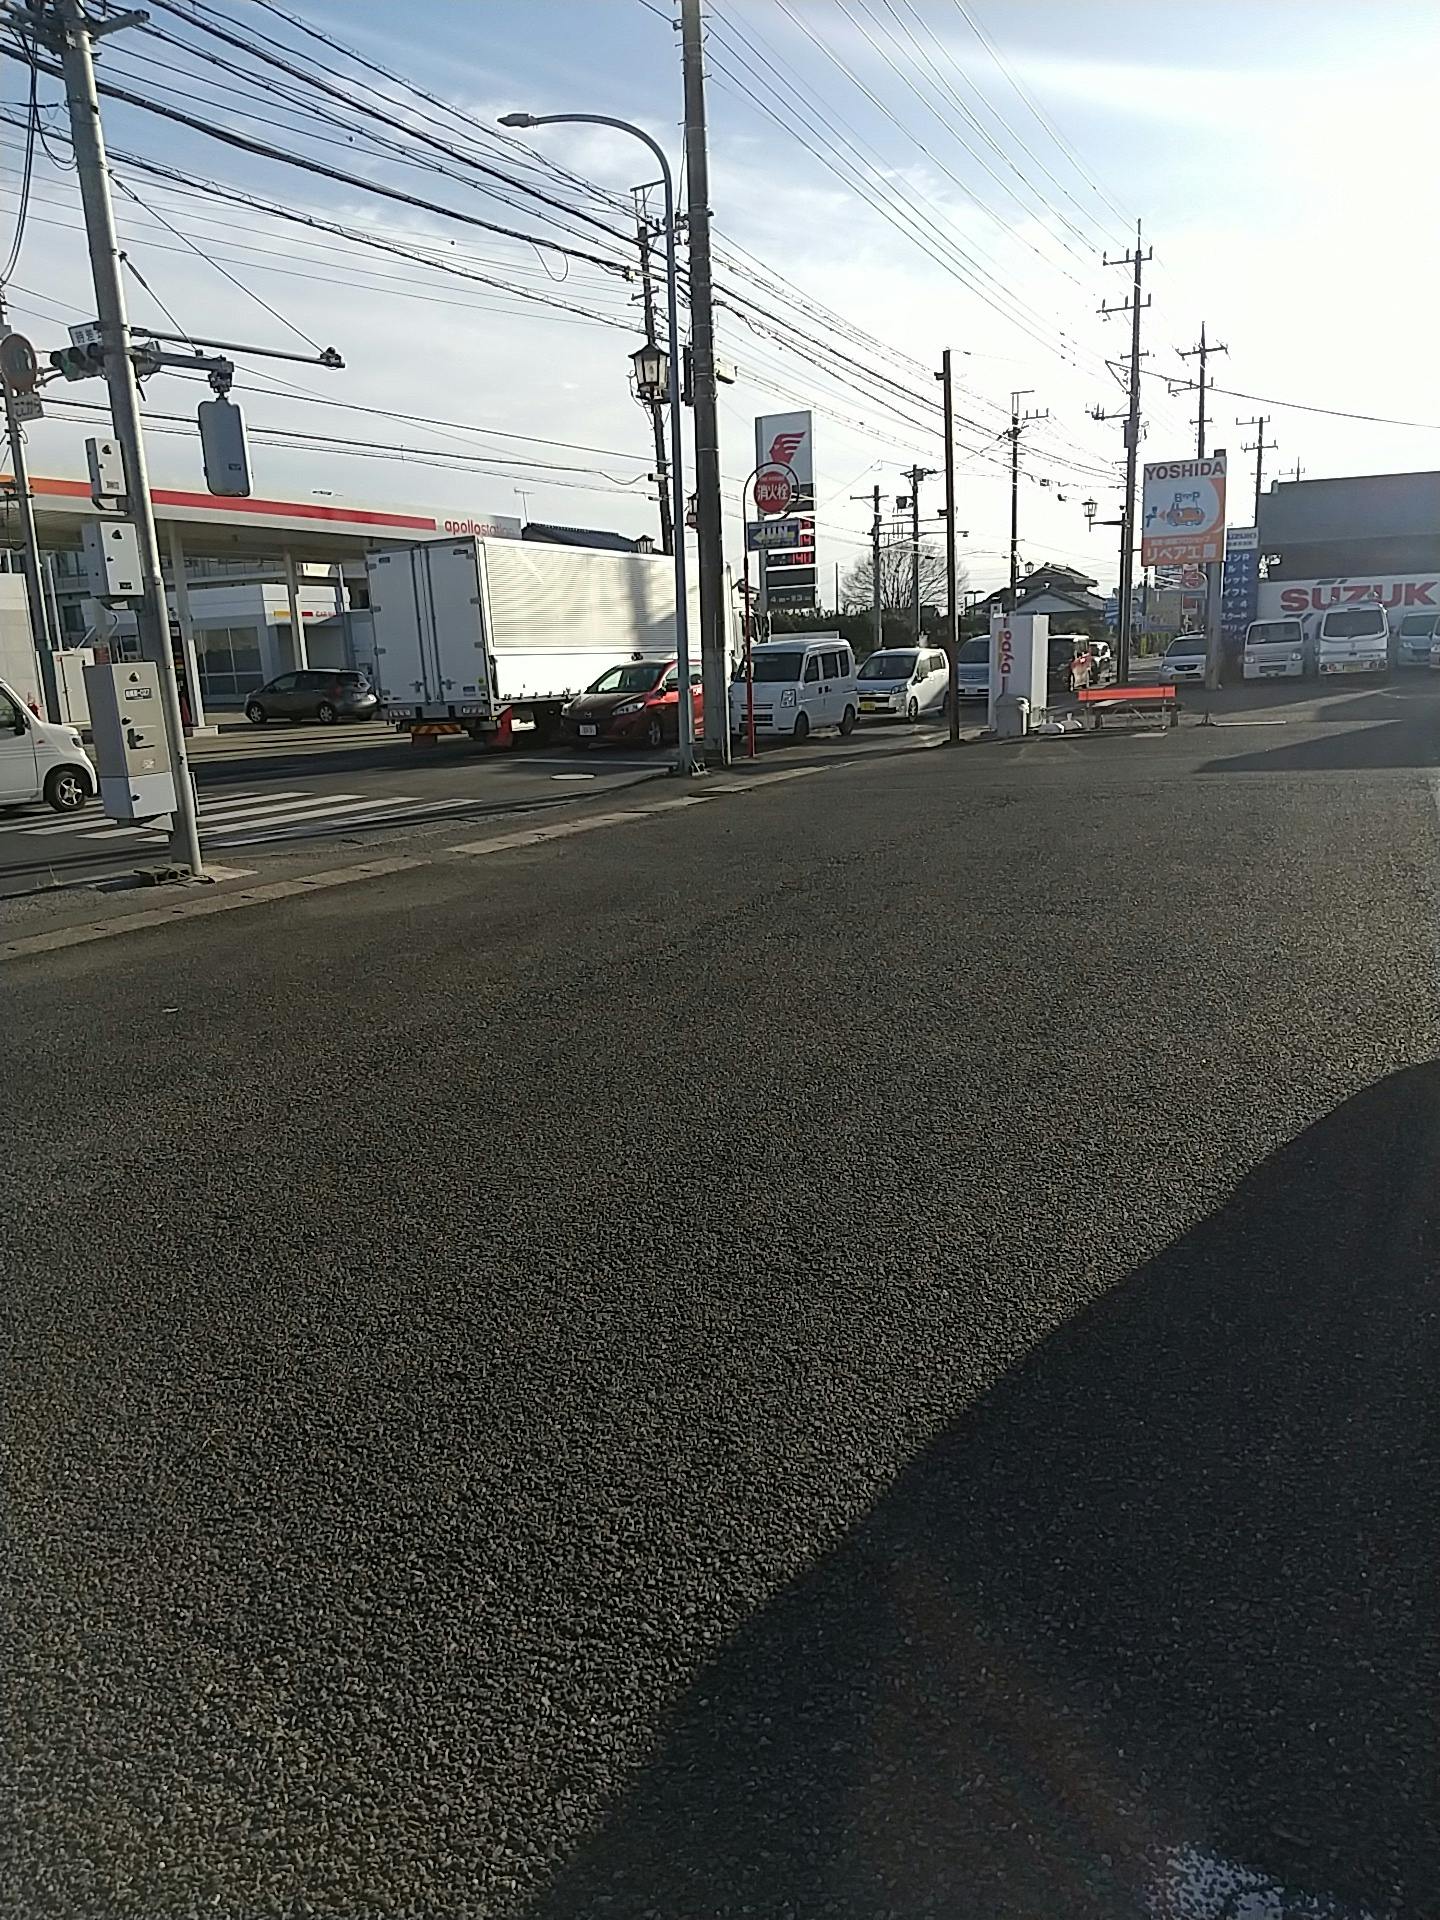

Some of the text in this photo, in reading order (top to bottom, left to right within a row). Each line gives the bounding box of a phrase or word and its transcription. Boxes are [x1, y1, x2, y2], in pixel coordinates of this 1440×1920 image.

[1145, 461, 1225, 481] YOSHIDA
[757, 482, 789, 501] 消火栓
[1001, 630, 1016, 674] DyDo
